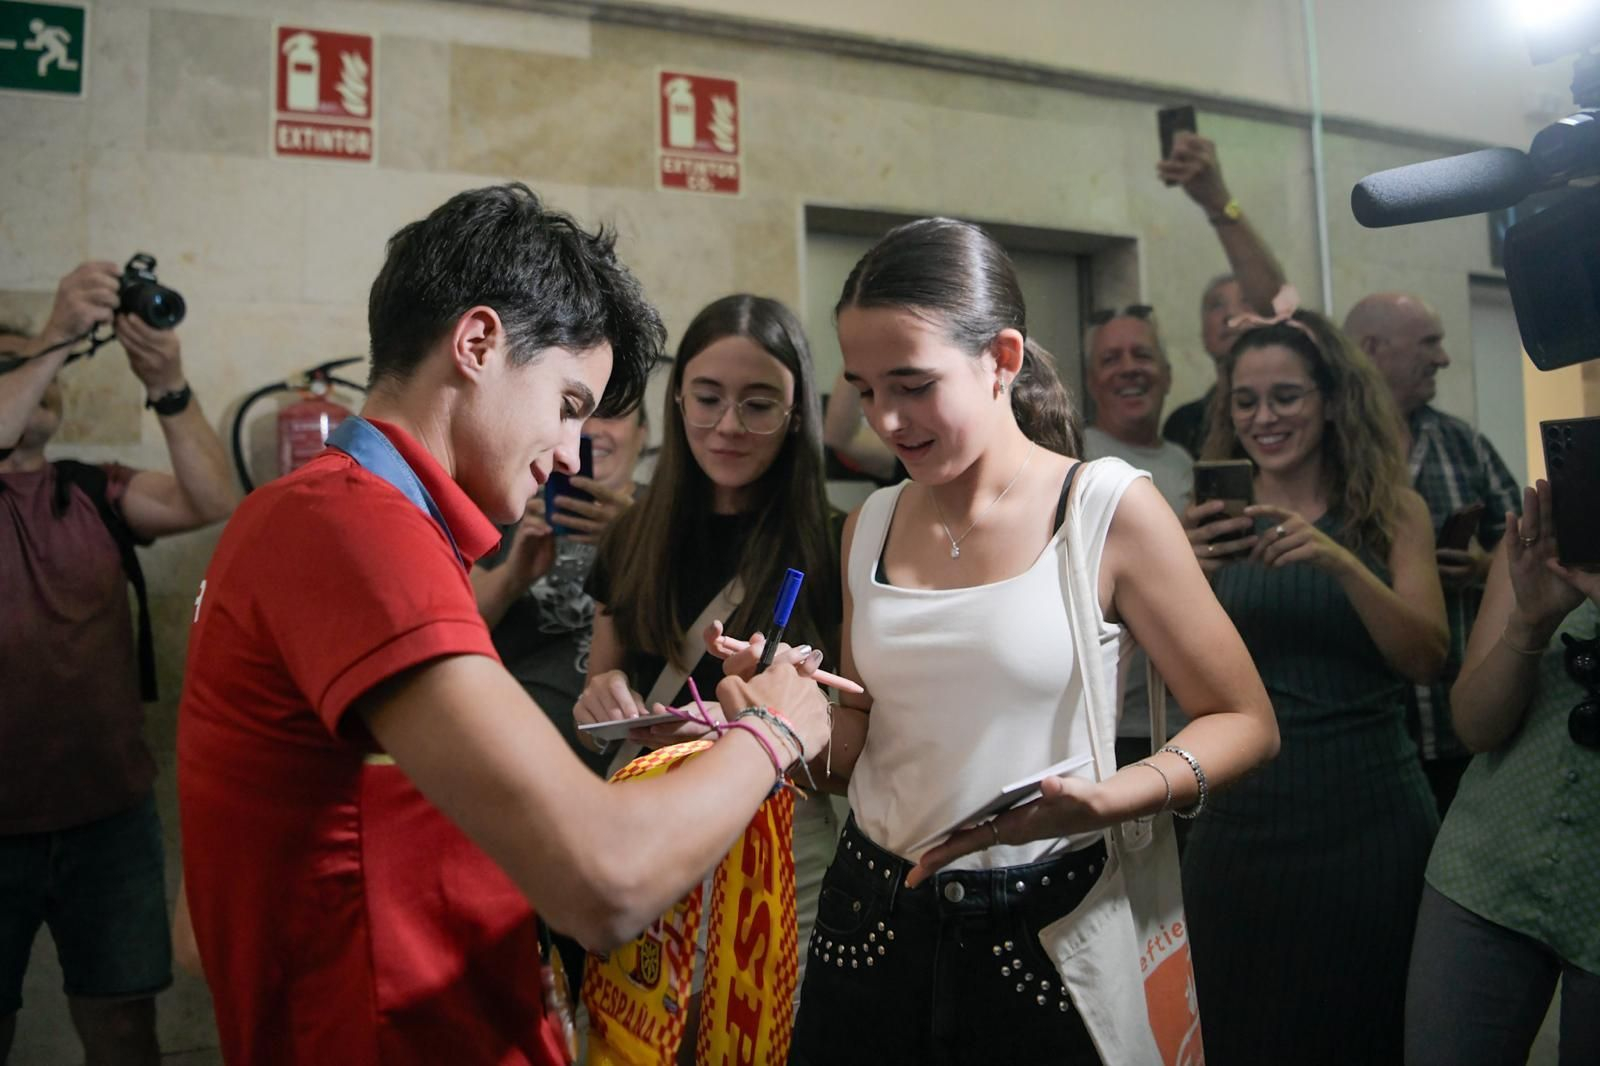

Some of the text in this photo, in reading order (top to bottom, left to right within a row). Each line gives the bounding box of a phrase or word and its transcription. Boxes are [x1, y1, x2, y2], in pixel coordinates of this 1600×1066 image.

[279, 125, 370, 153] EXTINTOR
[663, 158, 736, 178] EXTINTOR
[722, 803, 774, 1066] ESP
[1140, 922, 1184, 972] eftie
[600, 978, 657, 1043] ESPAÑA
